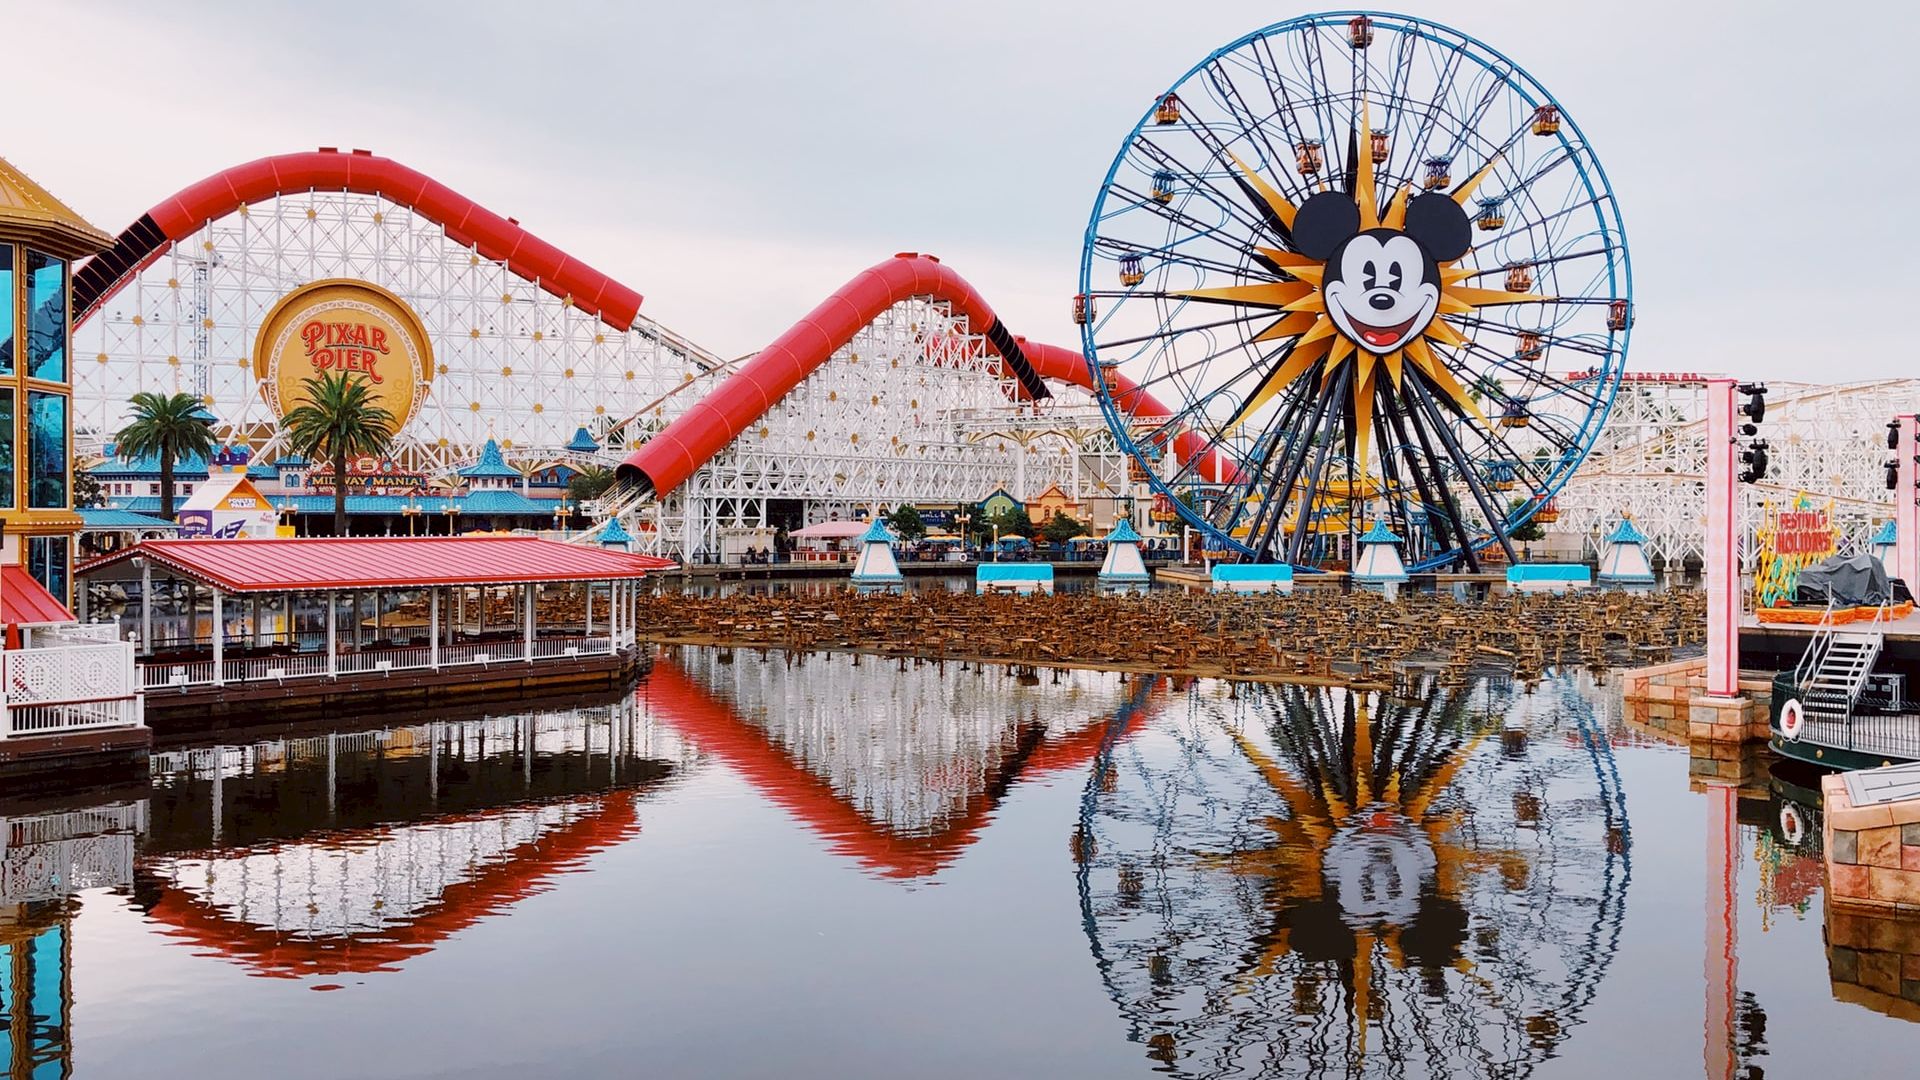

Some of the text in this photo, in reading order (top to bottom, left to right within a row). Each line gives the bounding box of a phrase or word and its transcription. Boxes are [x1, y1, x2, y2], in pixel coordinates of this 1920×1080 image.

[302, 320, 390, 354] PIXAR
[312, 348, 383, 383] PIER
[373, 476, 423, 486] MANIA!
[1780, 512, 1820, 529] FESTIVAL
[1775, 531, 1833, 554] HOLIDAYS
